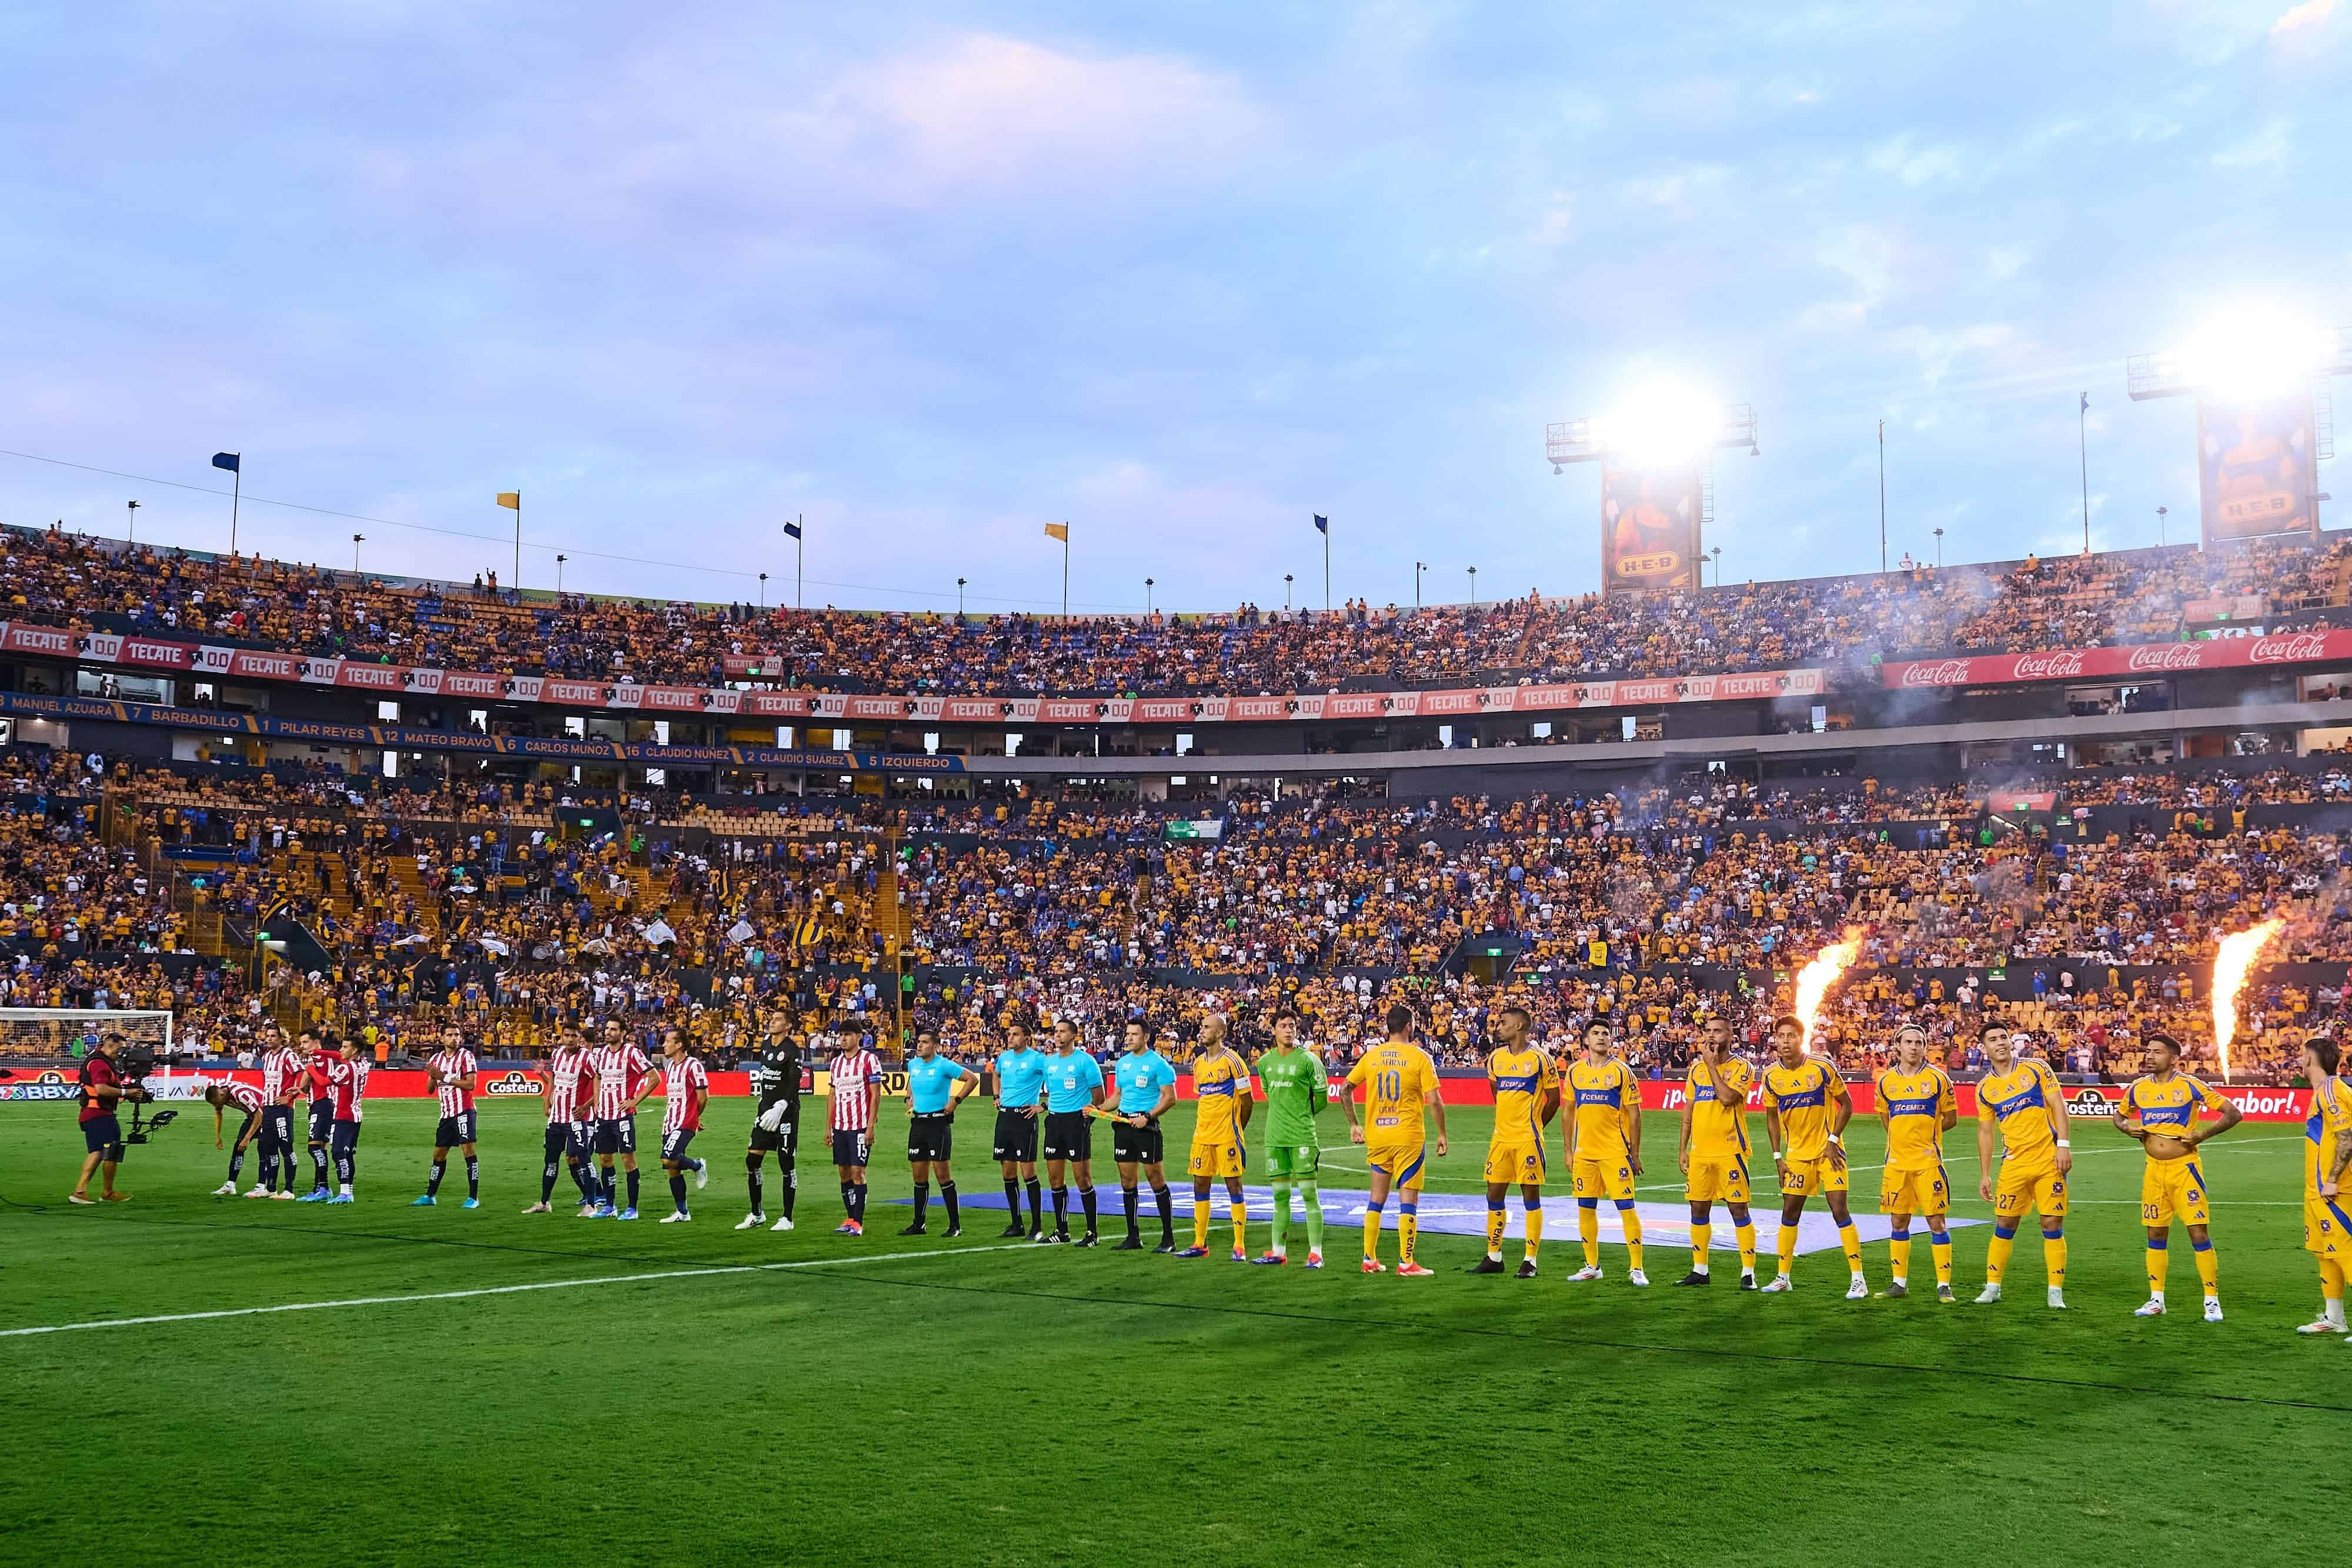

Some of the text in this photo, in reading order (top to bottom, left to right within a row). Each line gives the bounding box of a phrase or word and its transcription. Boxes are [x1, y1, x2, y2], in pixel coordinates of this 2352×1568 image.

[12, 630, 116, 656] TECATE 0.0
[2249, 634, 2328, 662] Coca-Cola
[128, 643, 229, 668] TECATE 0.0
[2129, 644, 2204, 670] Coca-Cola
[239, 656, 335, 678] TECATE 0.0
[727, 660, 753, 668] TECATE
[1903, 658, 1971, 686] Coca-Cola
[2014, 652, 2084, 678] Coca-Cola
[345, 667, 438, 688] TECATE 0.0
[1722, 674, 1815, 695] TECATE 0.0
[448, 677, 539, 696] TECATE 0.0
[550, 684, 639, 703] TECATE 0.0
[1621, 681, 1711, 700] TECATE 0.0
[649, 690, 736, 708] TECATE 0.0
[1427, 693, 1512, 709] TECATE 0.0
[1522, 686, 1611, 705] TECATE 0.0
[12, 698, 61, 711] MANUEL
[65, 703, 112, 716] AZUARA
[758, 697, 843, 713] TECATE 0.0
[854, 700, 940, 715] TECATE 0.0
[950, 703, 1035, 717] TECATE 0.0
[1047, 704, 1130, 717] TECATE 0.0
[1142, 703, 1225, 717] TECATE 0.0
[1236, 700, 1320, 716] TECATE 0.0
[1331, 697, 1416, 713] TECATE 0.0
[133, 707, 239, 728] 7 BARBADILLO
[263, 720, 365, 739] 1 PILAR REYES
[385, 731, 491, 748] 12 MATEO BRAVO
[508, 739, 516, 750] 6
[526, 742, 568, 753] CARLOS
[626, 746, 640, 757] 16
[646, 748, 692, 758] CLAUDIO
[747, 752, 754, 761] 2
[760, 753, 803, 764] CLAUDIO
[870, 756, 950, 768] 5 IZQUIERDO
[44, 1074, 59, 1084] La
[1378, 1070, 1399, 1102] 10
[490, 1082, 538, 1093] Costeña
[2083, 1092, 2098, 1102] La
[278, 1127, 287, 1138] 16
[458, 1123, 467, 1135] 19
[575, 1131, 582, 1142] 3
[623, 1132, 629, 1143] 4
[783, 1135, 788, 1147] 1
[857, 1144, 867, 1157] 15
[339, 1158, 349, 1179] PERDURA
[1789, 1175, 1804, 1188] 29
[1887, 1192, 1898, 1206] 17
[1999, 1195, 2016, 1209] 27
[2144, 1204, 2159, 1219] 20
[1491, 1228, 1502, 1246] viva
